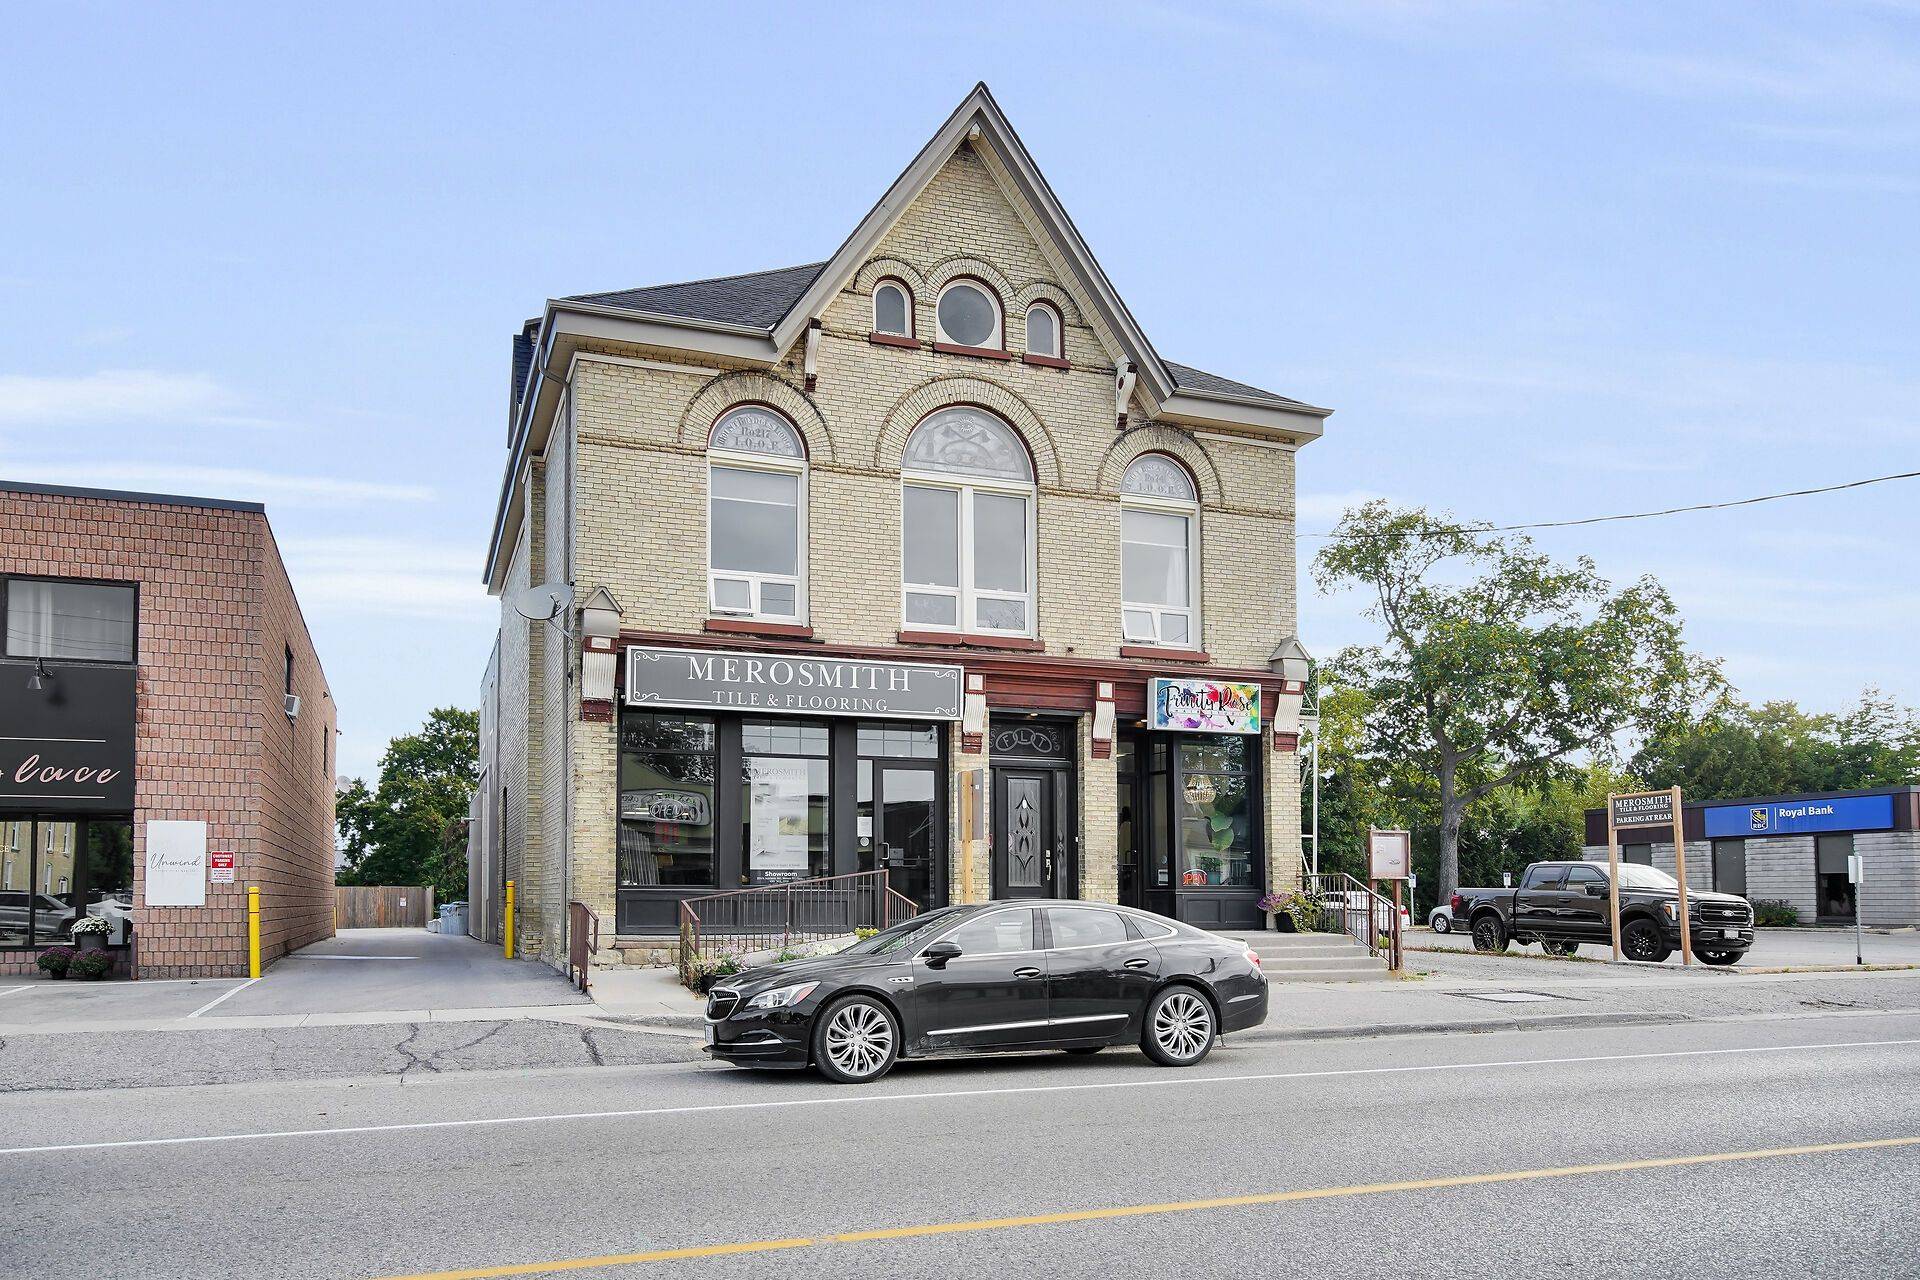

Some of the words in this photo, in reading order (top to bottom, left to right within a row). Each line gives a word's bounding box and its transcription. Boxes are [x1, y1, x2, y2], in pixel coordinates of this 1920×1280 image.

[687, 656, 911, 692] MEROSMITH
[713, 690, 760, 706] TILE
[767, 693, 779, 707] &
[786, 694, 889, 712] FLOORING
[1158, 685, 1214, 718] Trinity
[14, 754, 121, 784] lace
[1615, 795, 1672, 808] MEROSMITH
[1639, 803, 1668, 811] FLOORING
[1616, 815, 1645, 823] PARKING
[1654, 813, 1673, 821] REAR
[1779, 807, 1806, 819] Royal
[1808, 805, 1834, 816] Bank
[150, 852, 201, 869] Unwind
